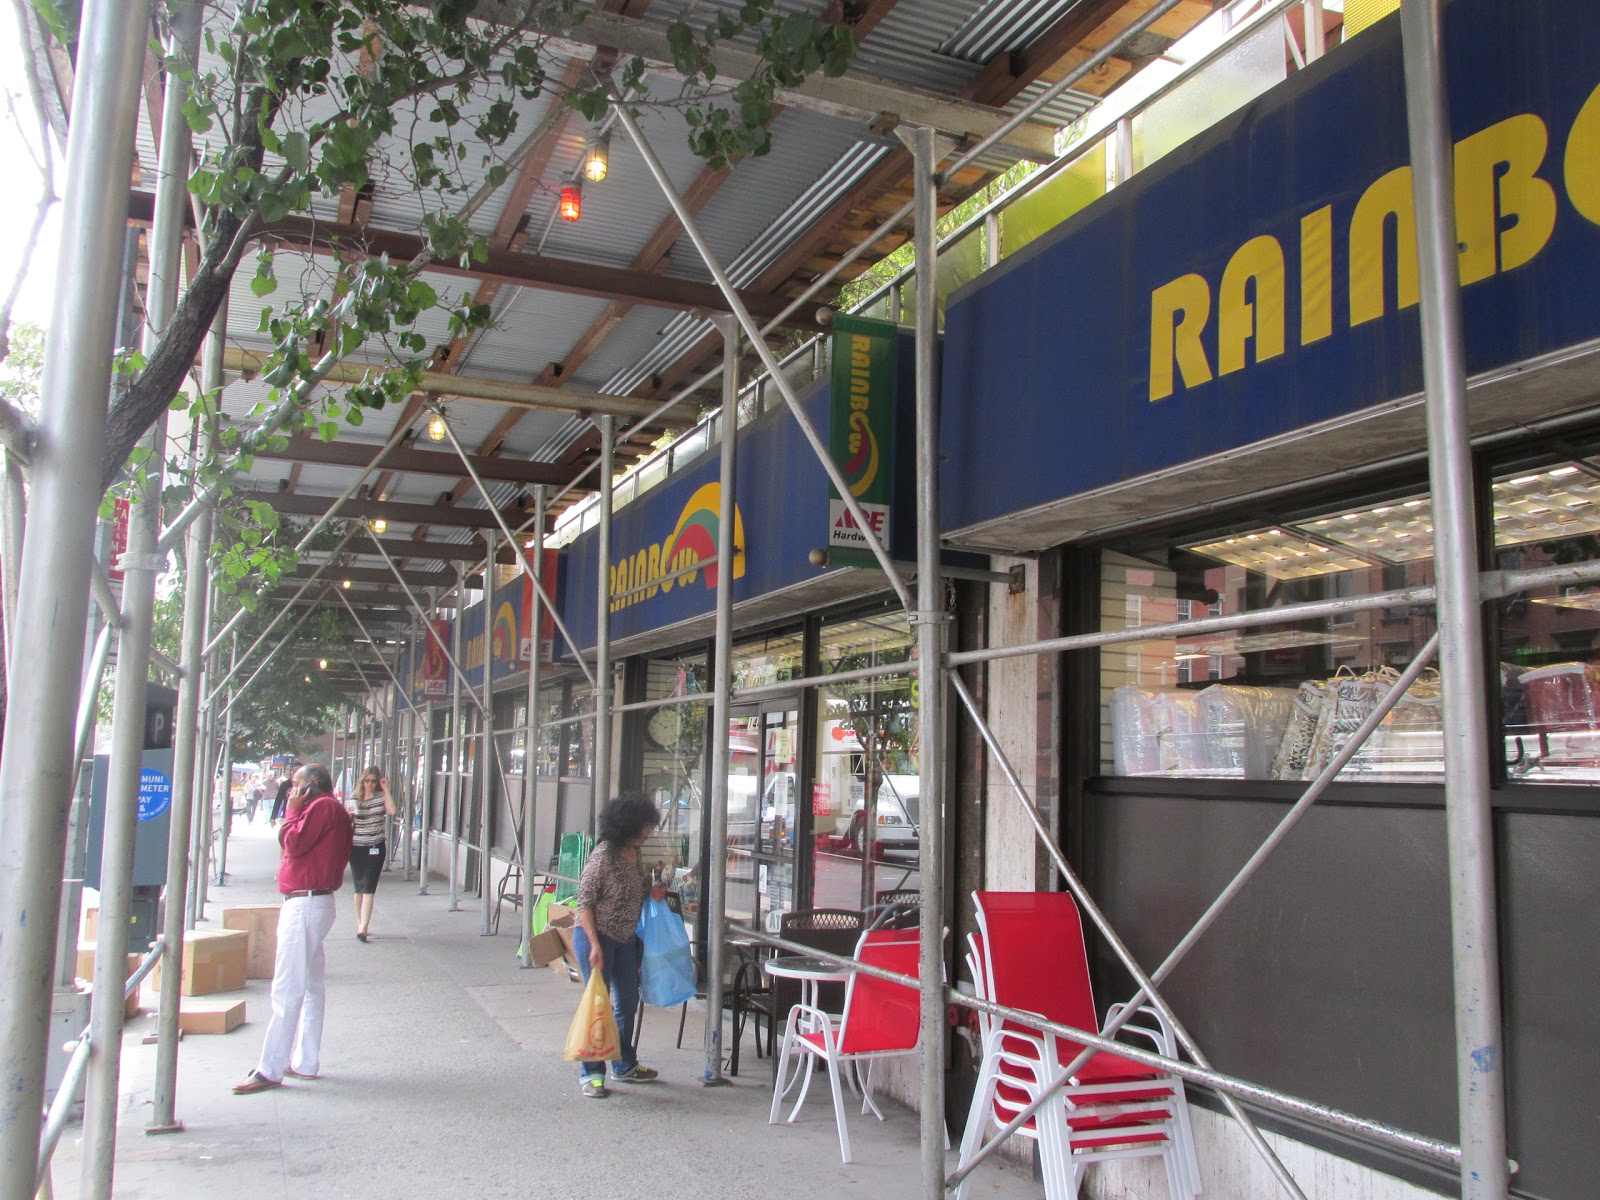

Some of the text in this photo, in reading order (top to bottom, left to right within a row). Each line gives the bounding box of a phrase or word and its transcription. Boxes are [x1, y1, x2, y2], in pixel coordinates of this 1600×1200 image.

[848, 334, 871, 454] RAINBOW
[833, 530, 882, 543] Hardwe
[524, 642, 550, 654] AE
[141, 775, 164, 783] MUNI
[140, 784, 170, 793] METER
[769, 912, 781, 931] AT
